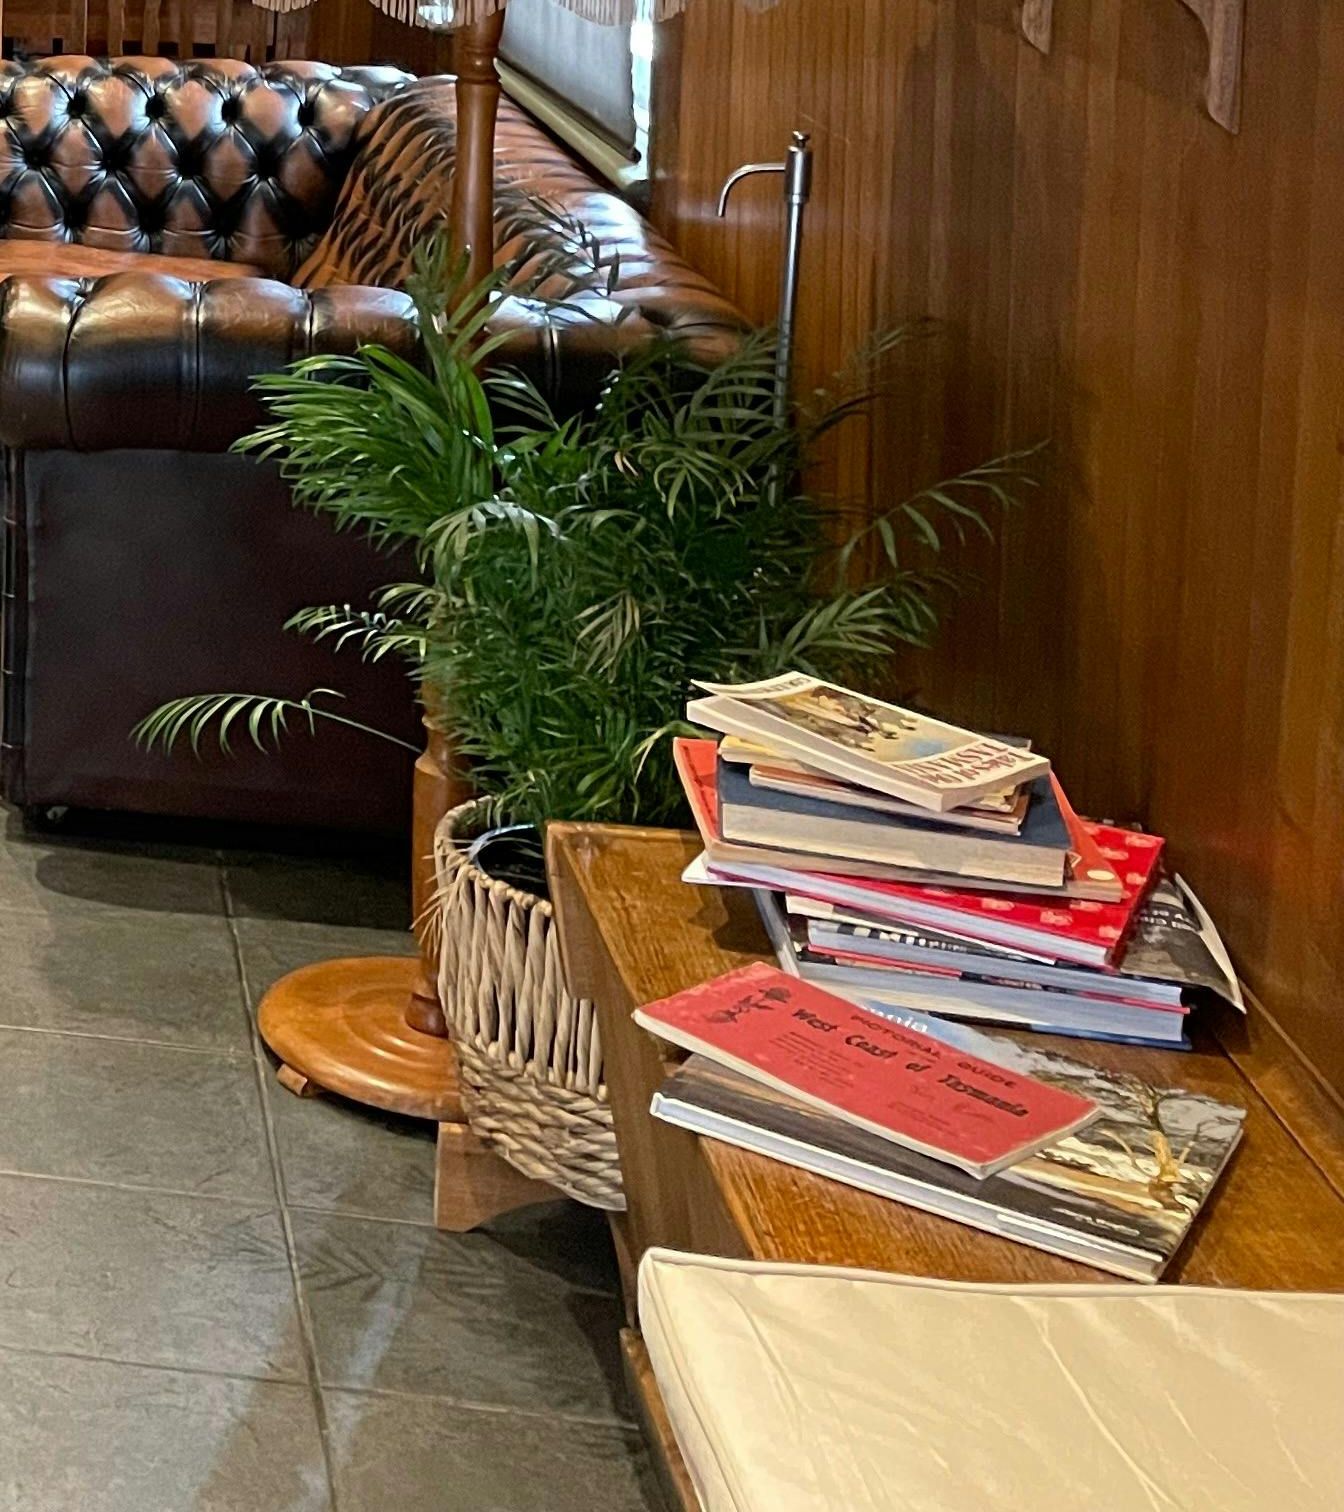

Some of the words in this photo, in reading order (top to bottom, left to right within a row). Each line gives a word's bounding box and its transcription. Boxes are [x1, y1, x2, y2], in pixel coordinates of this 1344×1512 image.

[791, 1008, 839, 1033] West
[844, 1034, 899, 1060] Coast
[905, 1059, 932, 1073] of
[937, 1073, 1030, 1118] Tasmania
[850, 1014, 942, 1060] PICTORIAL
[956, 1061, 1018, 1087] GUIDE
